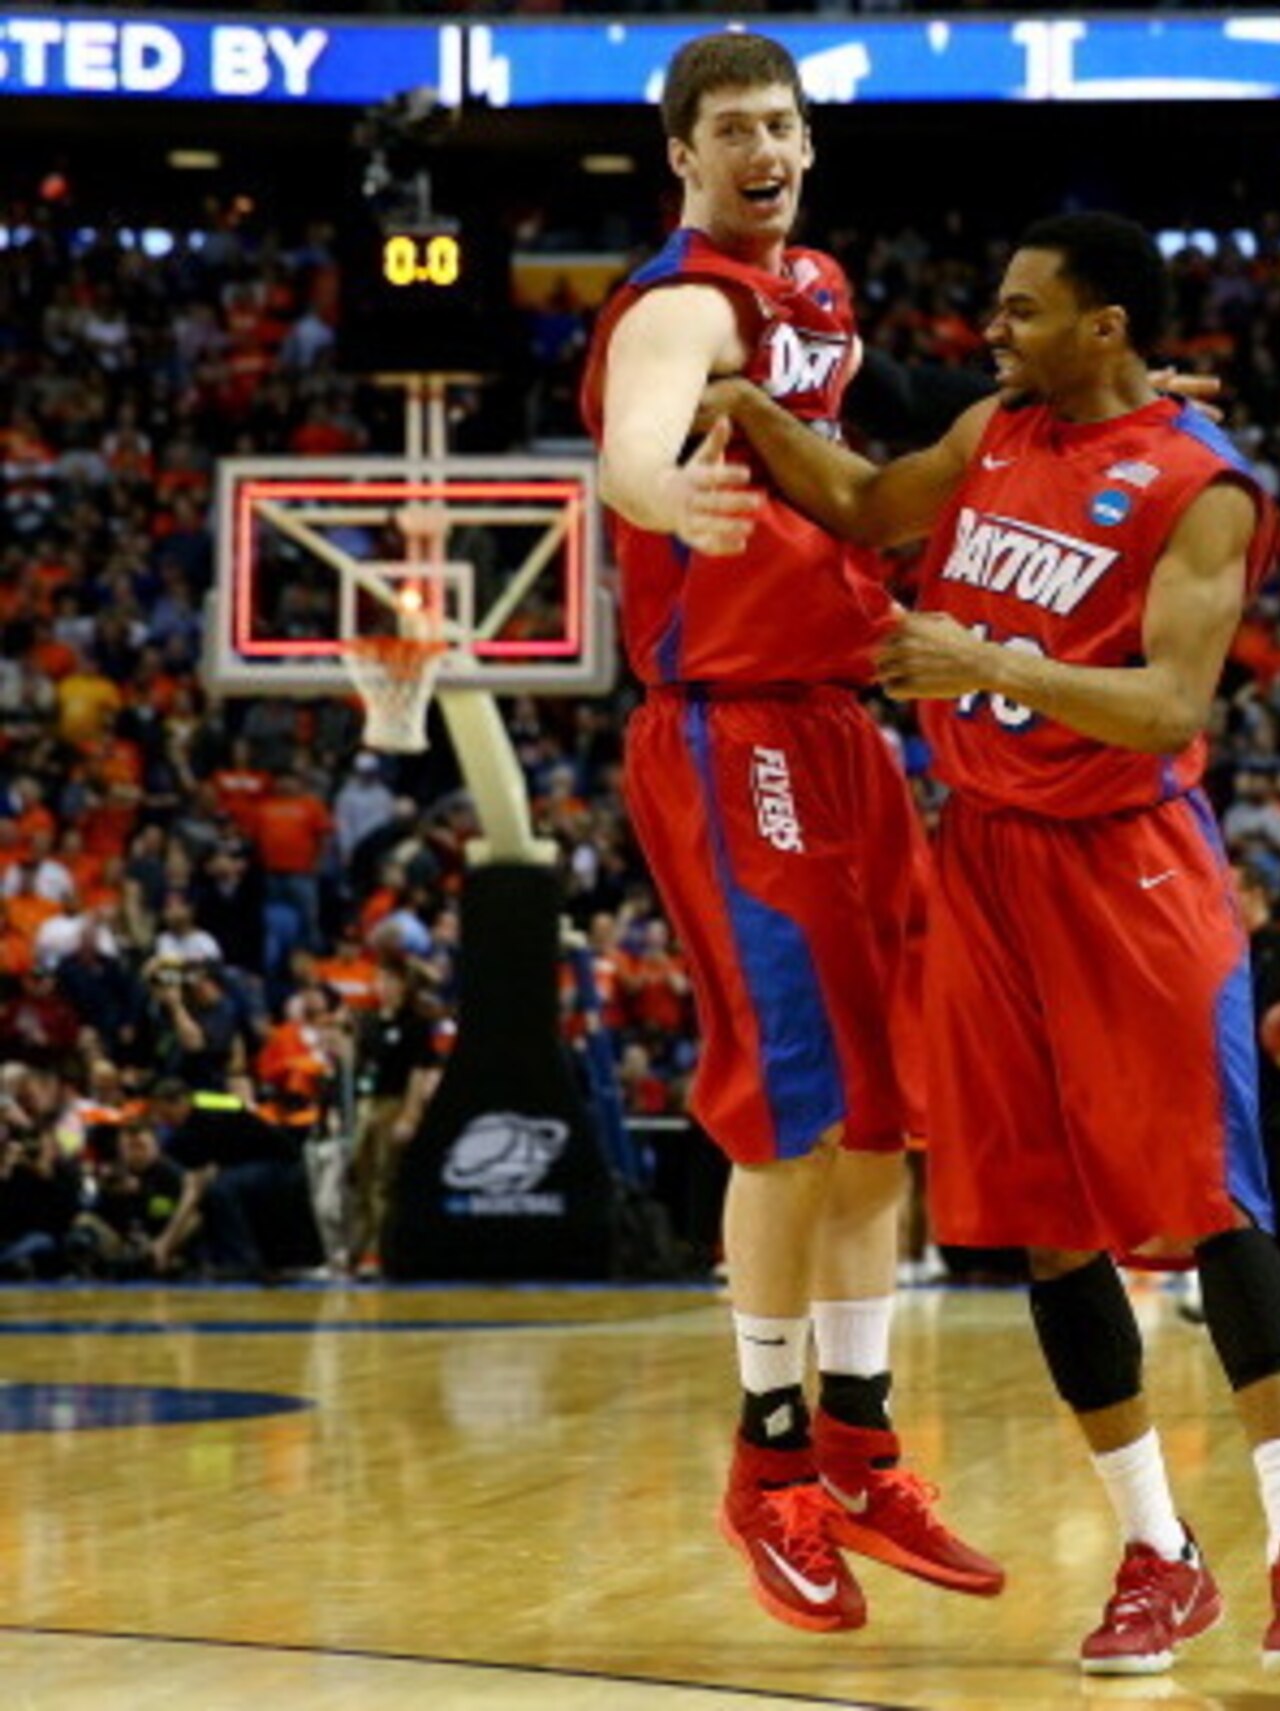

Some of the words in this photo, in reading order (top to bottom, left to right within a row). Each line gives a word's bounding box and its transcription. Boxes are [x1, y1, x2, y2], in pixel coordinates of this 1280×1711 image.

[0, 18, 184, 92] TED
[211, 26, 329, 97] BY
[384, 235, 460, 286] 0.0
[751, 745, 805, 855] FLYERS
